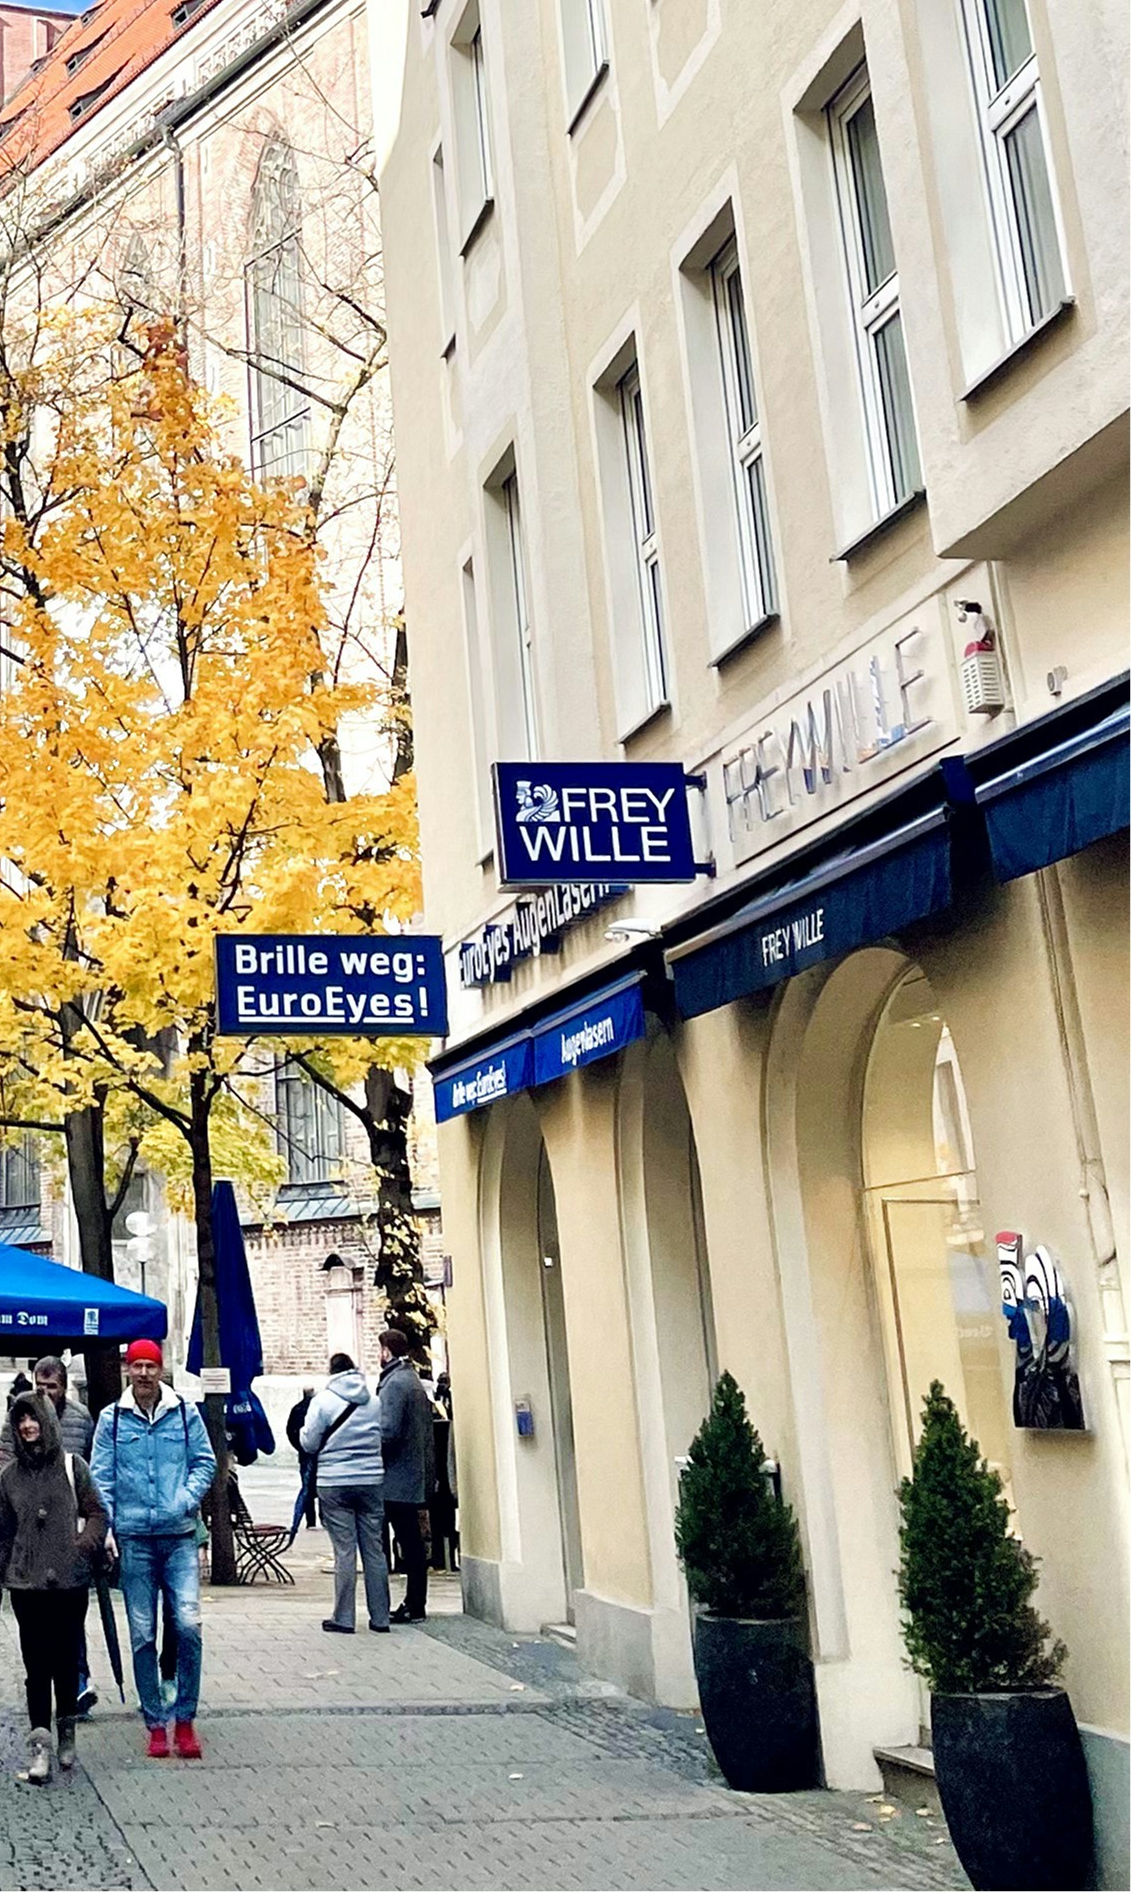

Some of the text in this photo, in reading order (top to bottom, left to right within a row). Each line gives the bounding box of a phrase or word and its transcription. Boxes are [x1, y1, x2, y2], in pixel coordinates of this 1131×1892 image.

[561, 787, 675, 824] FREY
[519, 825, 672, 862] WILLE
[761, 908, 825, 967] FREY WILLE
[234, 944, 426, 983] Brille weg:
[238, 985, 429, 1023] EuroEyes!
[17, 1311, 48, 1326] Dom
